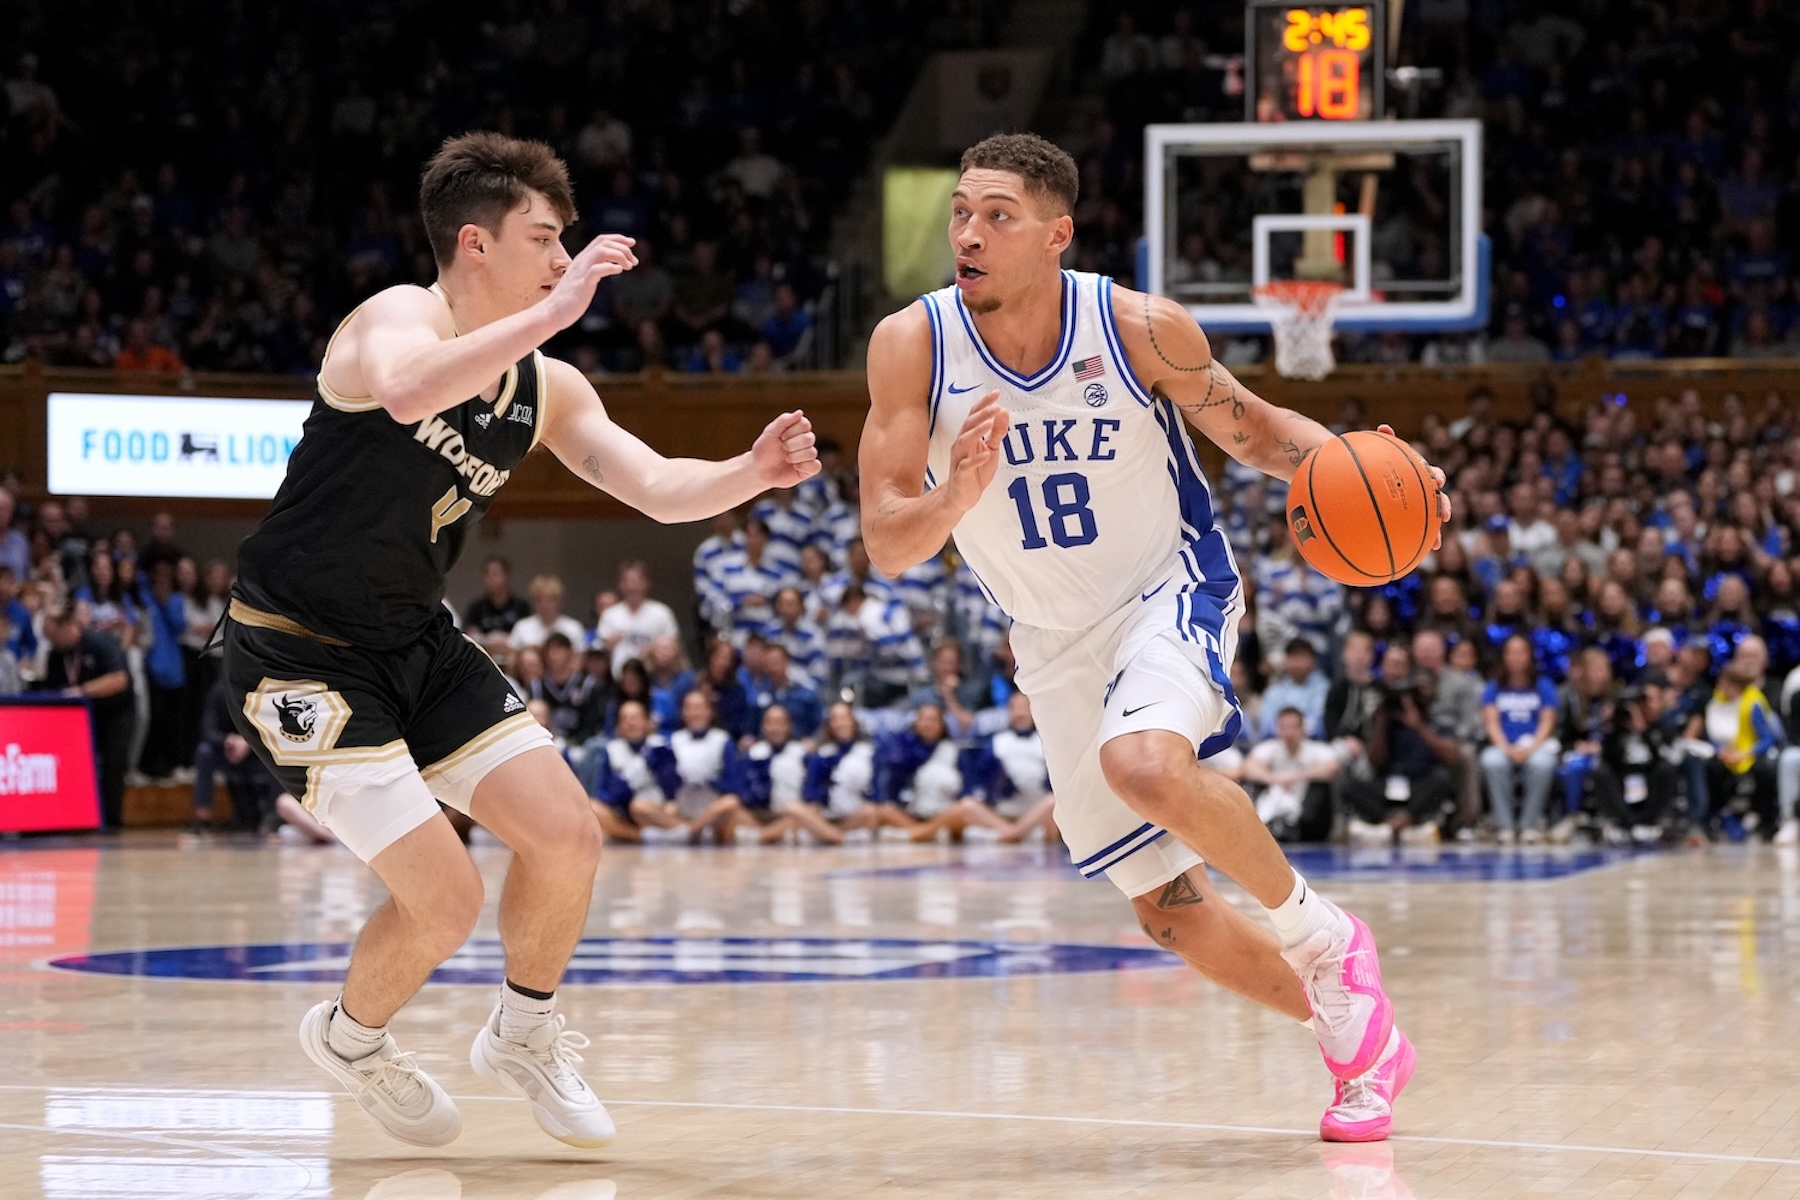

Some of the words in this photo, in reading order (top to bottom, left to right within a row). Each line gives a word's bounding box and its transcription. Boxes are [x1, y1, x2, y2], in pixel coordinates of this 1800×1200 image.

[1283, 8, 1371, 52] 2:45
[1297, 48, 1360, 120] 18
[82, 429, 169, 462] FOOD
[1002, 418, 1121, 466] UKE
[430, 484, 473, 544] 4
[1007, 472, 1099, 550] 18
